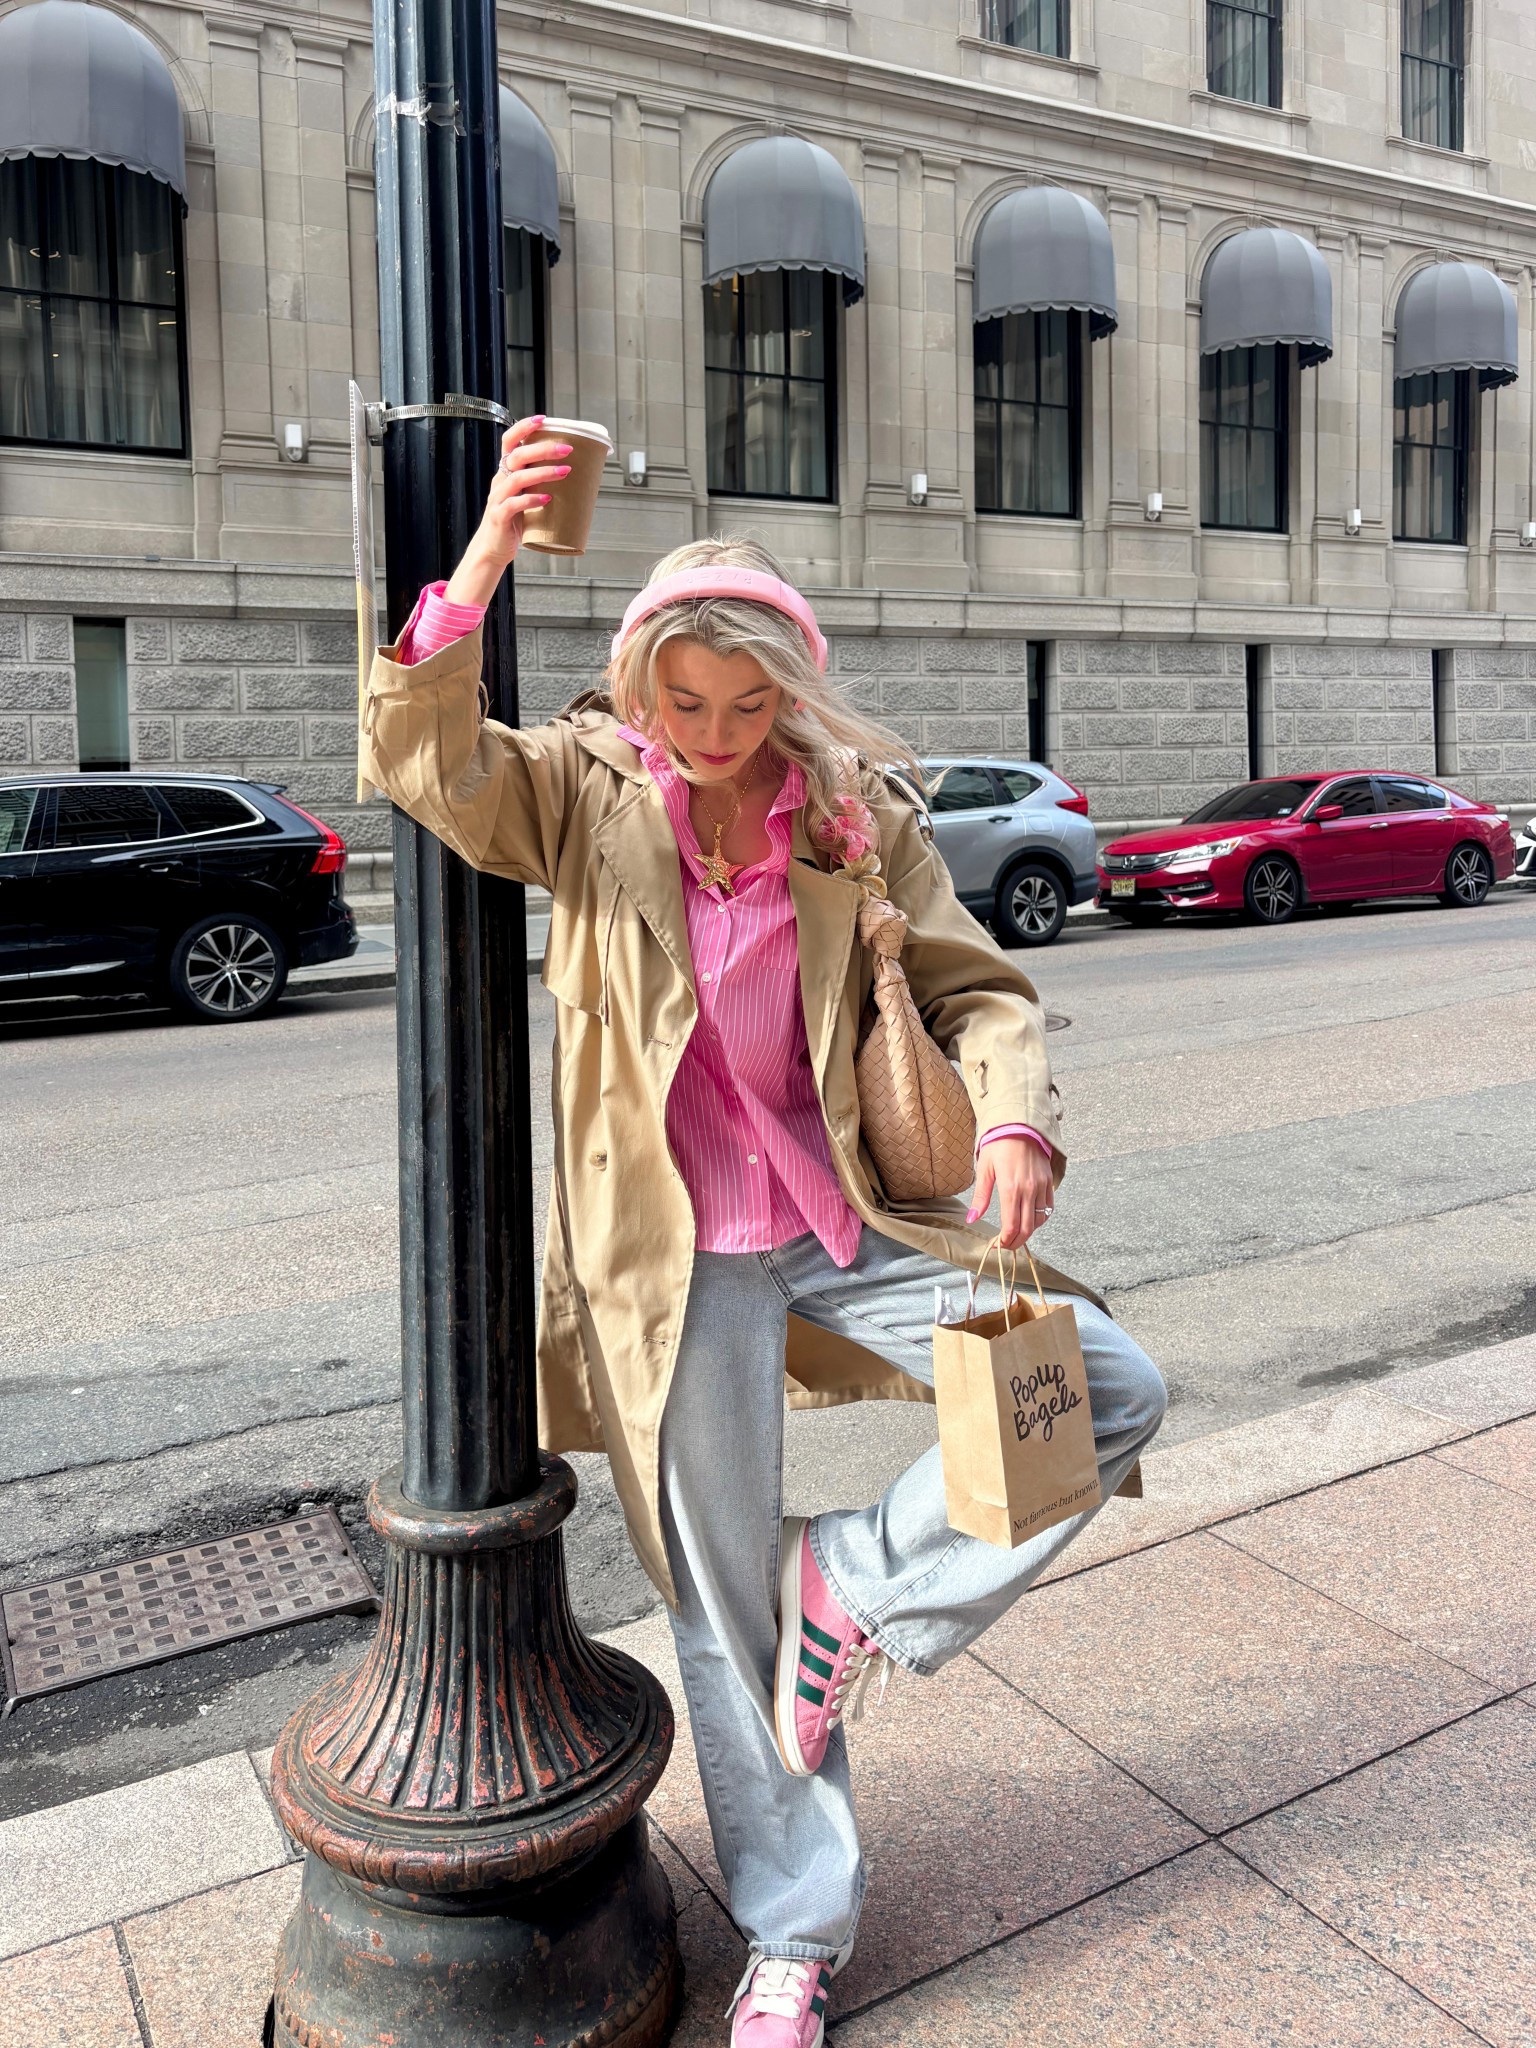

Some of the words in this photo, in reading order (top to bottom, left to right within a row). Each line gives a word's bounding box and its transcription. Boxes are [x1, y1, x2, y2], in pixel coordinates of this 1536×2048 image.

[1014, 1384, 1082, 1441] Bagels
[1014, 1517, 1028, 1532] Not
[1029, 1501, 1058, 1524] famous
[1059, 1494, 1073, 1507] but
